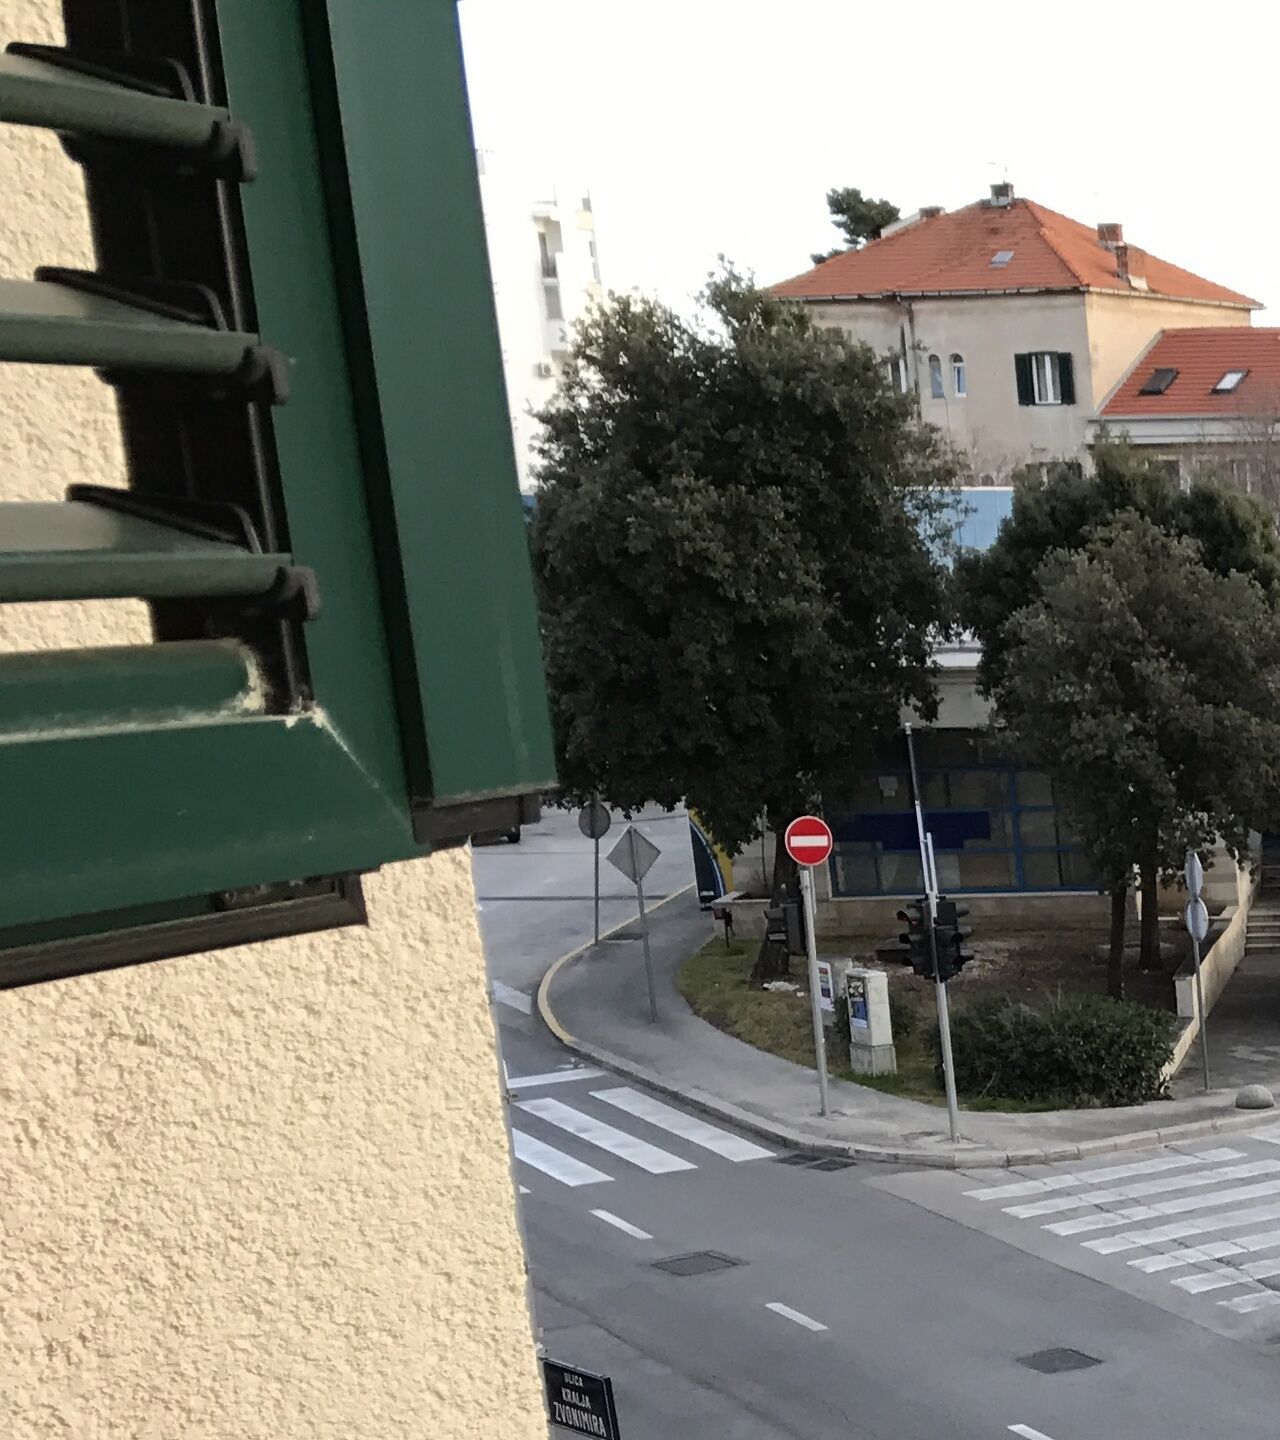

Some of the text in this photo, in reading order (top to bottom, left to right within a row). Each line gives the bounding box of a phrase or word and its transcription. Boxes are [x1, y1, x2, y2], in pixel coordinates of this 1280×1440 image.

[563, 1372, 584, 1387] ULICA
[560, 1386, 592, 1410] KRALJA
[553, 1401, 607, 1437] ZVONIMIRA
